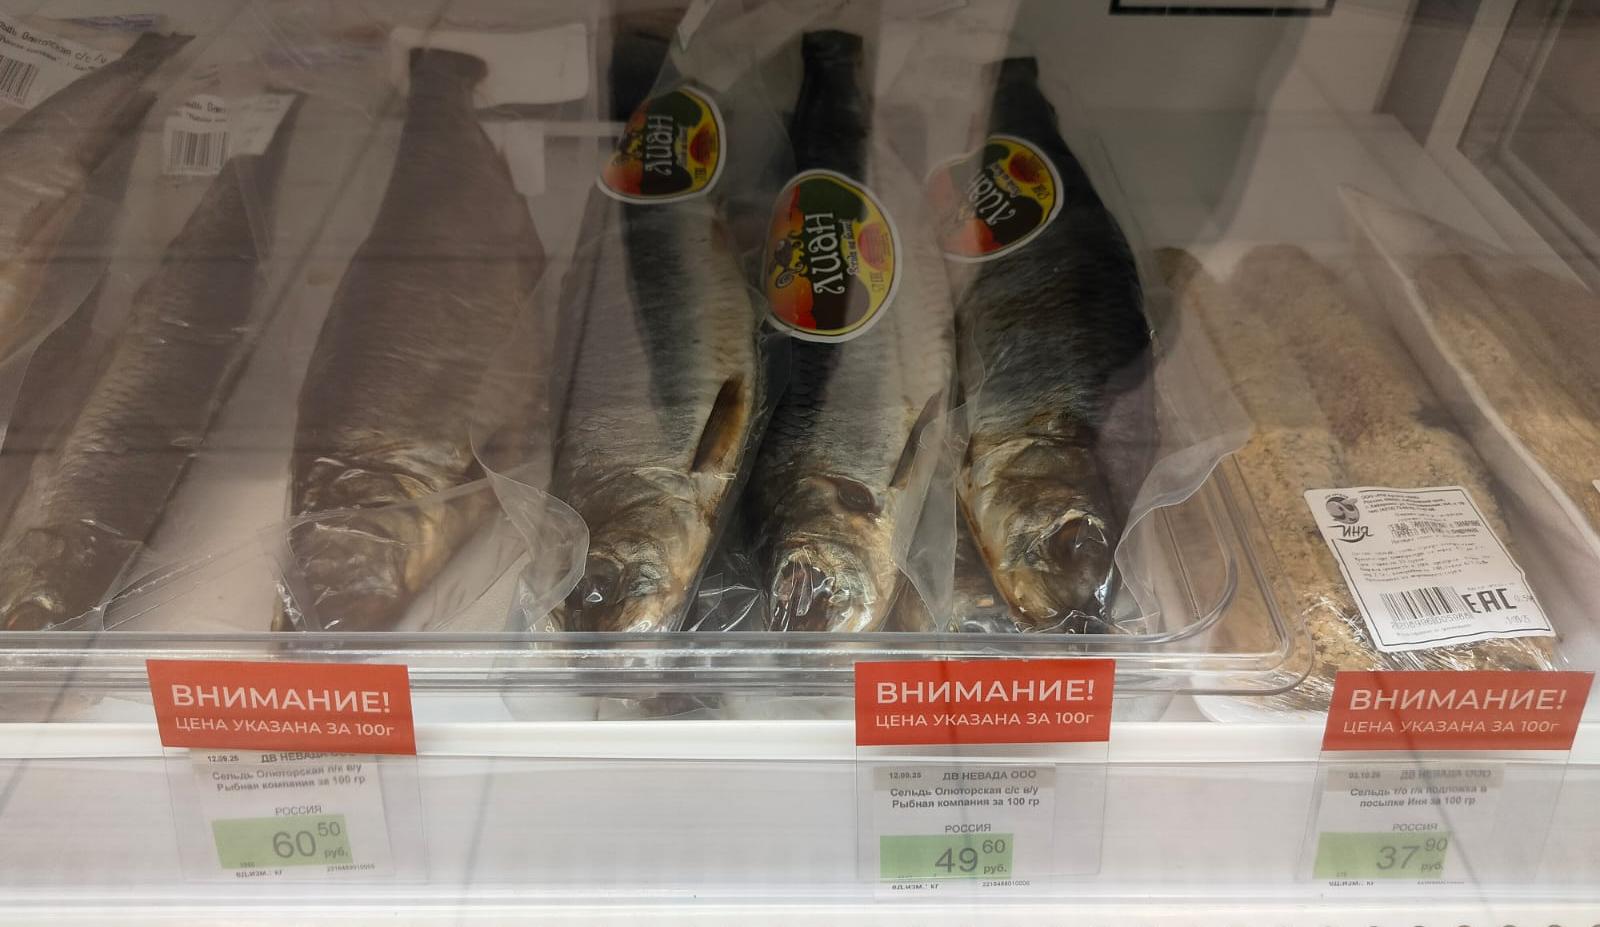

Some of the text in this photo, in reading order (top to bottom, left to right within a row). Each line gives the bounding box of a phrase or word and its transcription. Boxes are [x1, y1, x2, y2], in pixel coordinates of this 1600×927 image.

[877, 679, 1094, 704] ВНИМАНИЕ!
[171, 684, 391, 714] ВНИМАНИЕ!
[1350, 688, 1567, 711] ВНИМАНИЕ!
[175, 717, 395, 736] ЦЕНА УКАЗАНА ЗА 100г
[876, 712, 1094, 729] ЦЕНА УКАЗАНА ЗА 100г
[1343, 720, 1560, 735] ЦЕНА УКАЗАНА ЗА 100г
[332, 775, 351, 785] 100
[943, 769, 1037, 781] ДВ НЕВАДА ООО
[935, 786, 1002, 799] Олюторская
[1005, 785, 1020, 796] с/с
[892, 797, 1040, 809] Рыбная компания за 100 гр
[1445, 795, 1462, 805] 100
[1464, 796, 1476, 807] гр
[275, 805, 322, 816] РОССИЯ
[945, 823, 992, 833] РОССИЯ
[1392, 823, 1438, 832] РОССИЯ
[272, 821, 341, 858] 60 50
[324, 846, 349, 859] руб.
[934, 839, 1006, 874] 49 60
[1376, 837, 1448, 870] 37 90
[983, 863, 1008, 875] руб.
